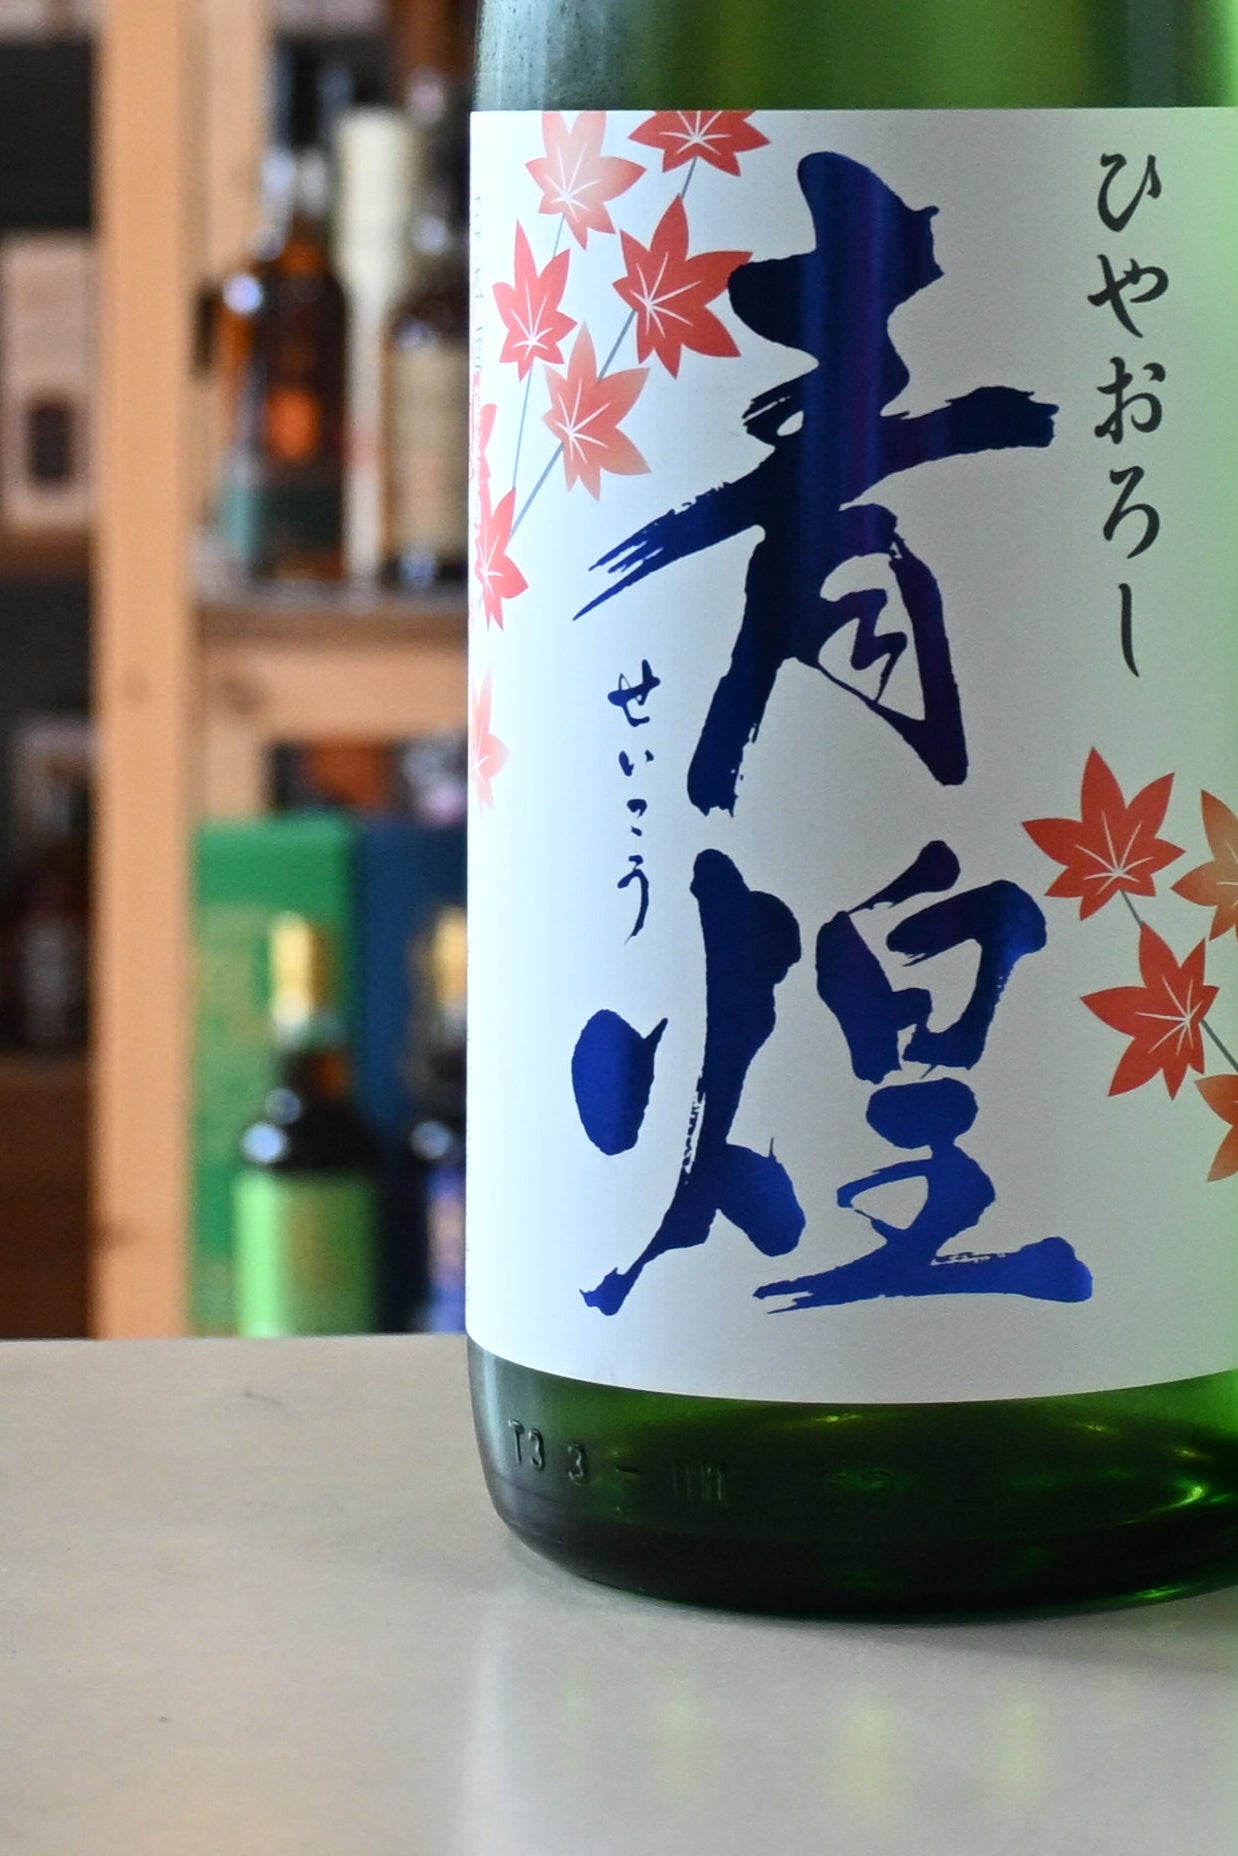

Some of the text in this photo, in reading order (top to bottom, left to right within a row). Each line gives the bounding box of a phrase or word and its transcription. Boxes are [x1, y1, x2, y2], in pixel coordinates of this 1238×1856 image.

[1087, 149, 1169, 679] ひやおろし
